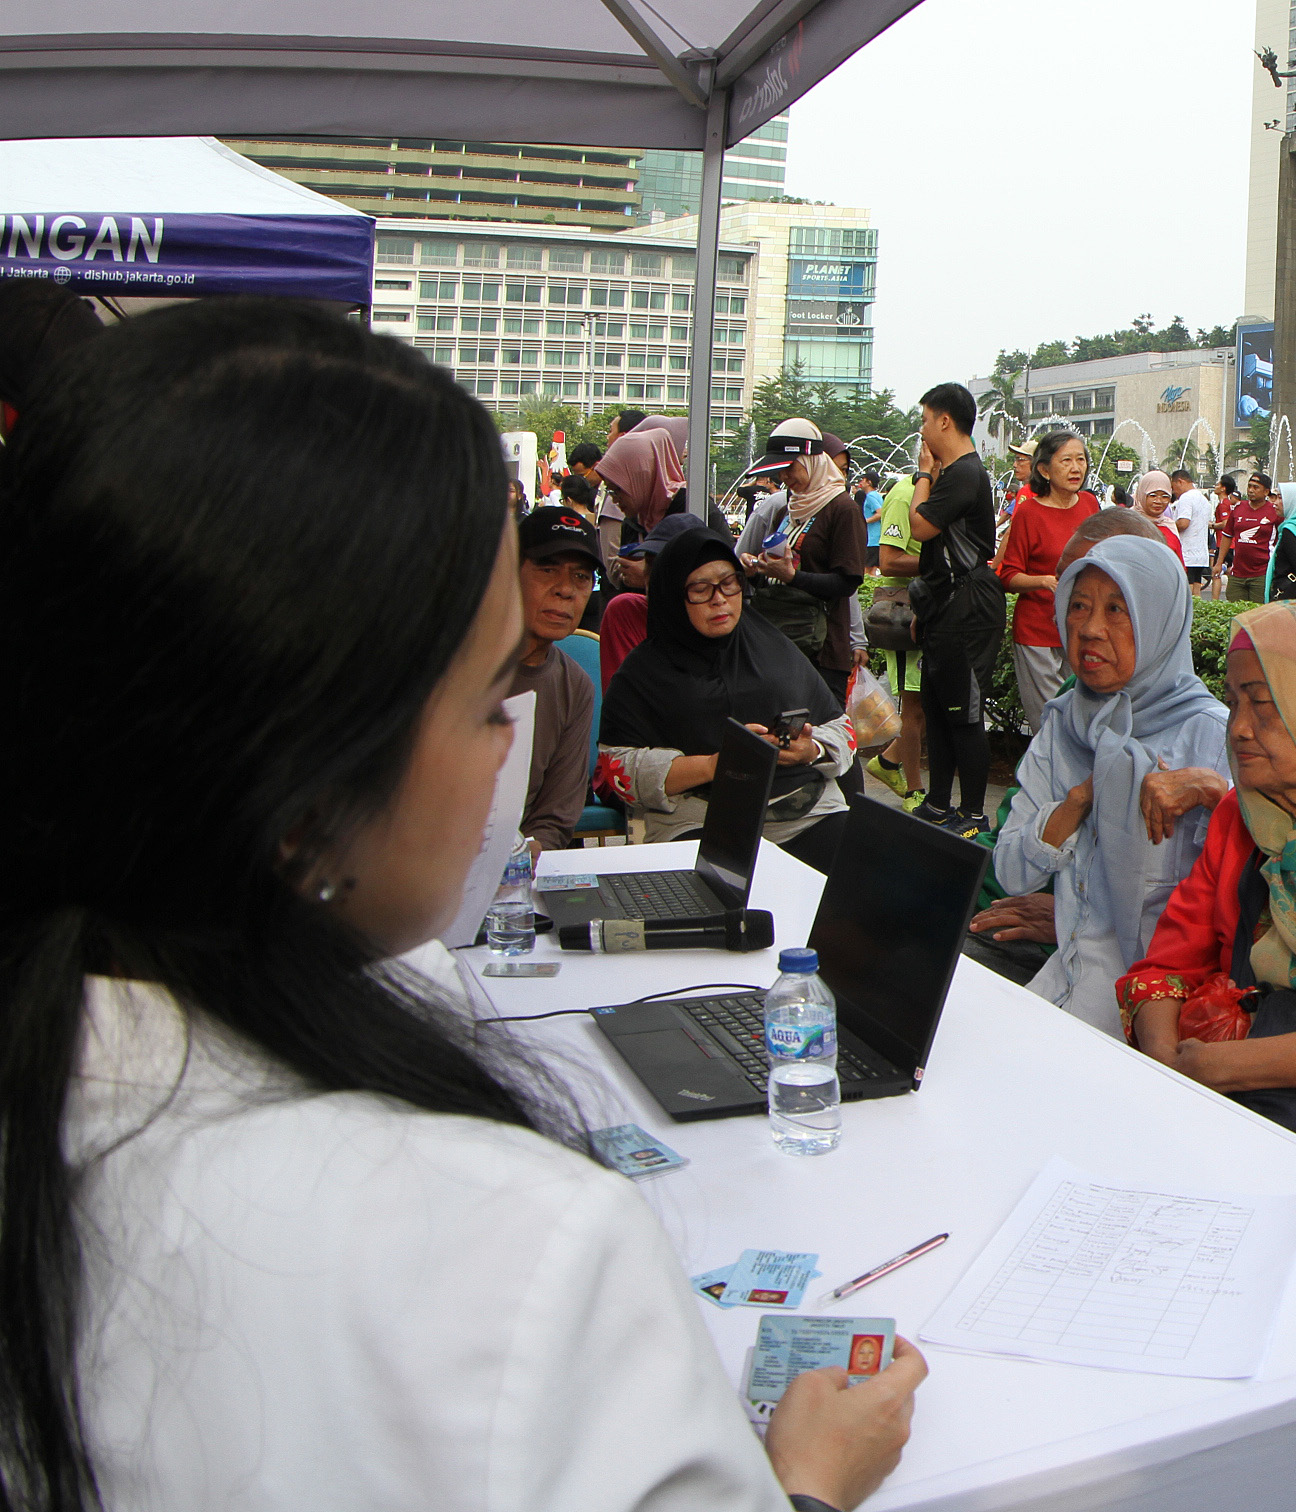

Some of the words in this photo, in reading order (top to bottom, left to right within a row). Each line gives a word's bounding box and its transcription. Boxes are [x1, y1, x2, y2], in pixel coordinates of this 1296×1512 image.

[7, 267, 49, 279] Jakarta
[84, 269, 195, 285] dishub.jakarta.go.id
[805, 264, 851, 275] PLANET
[807, 311, 834, 320] Locker
[770, 1028, 802, 1045] AQUA
